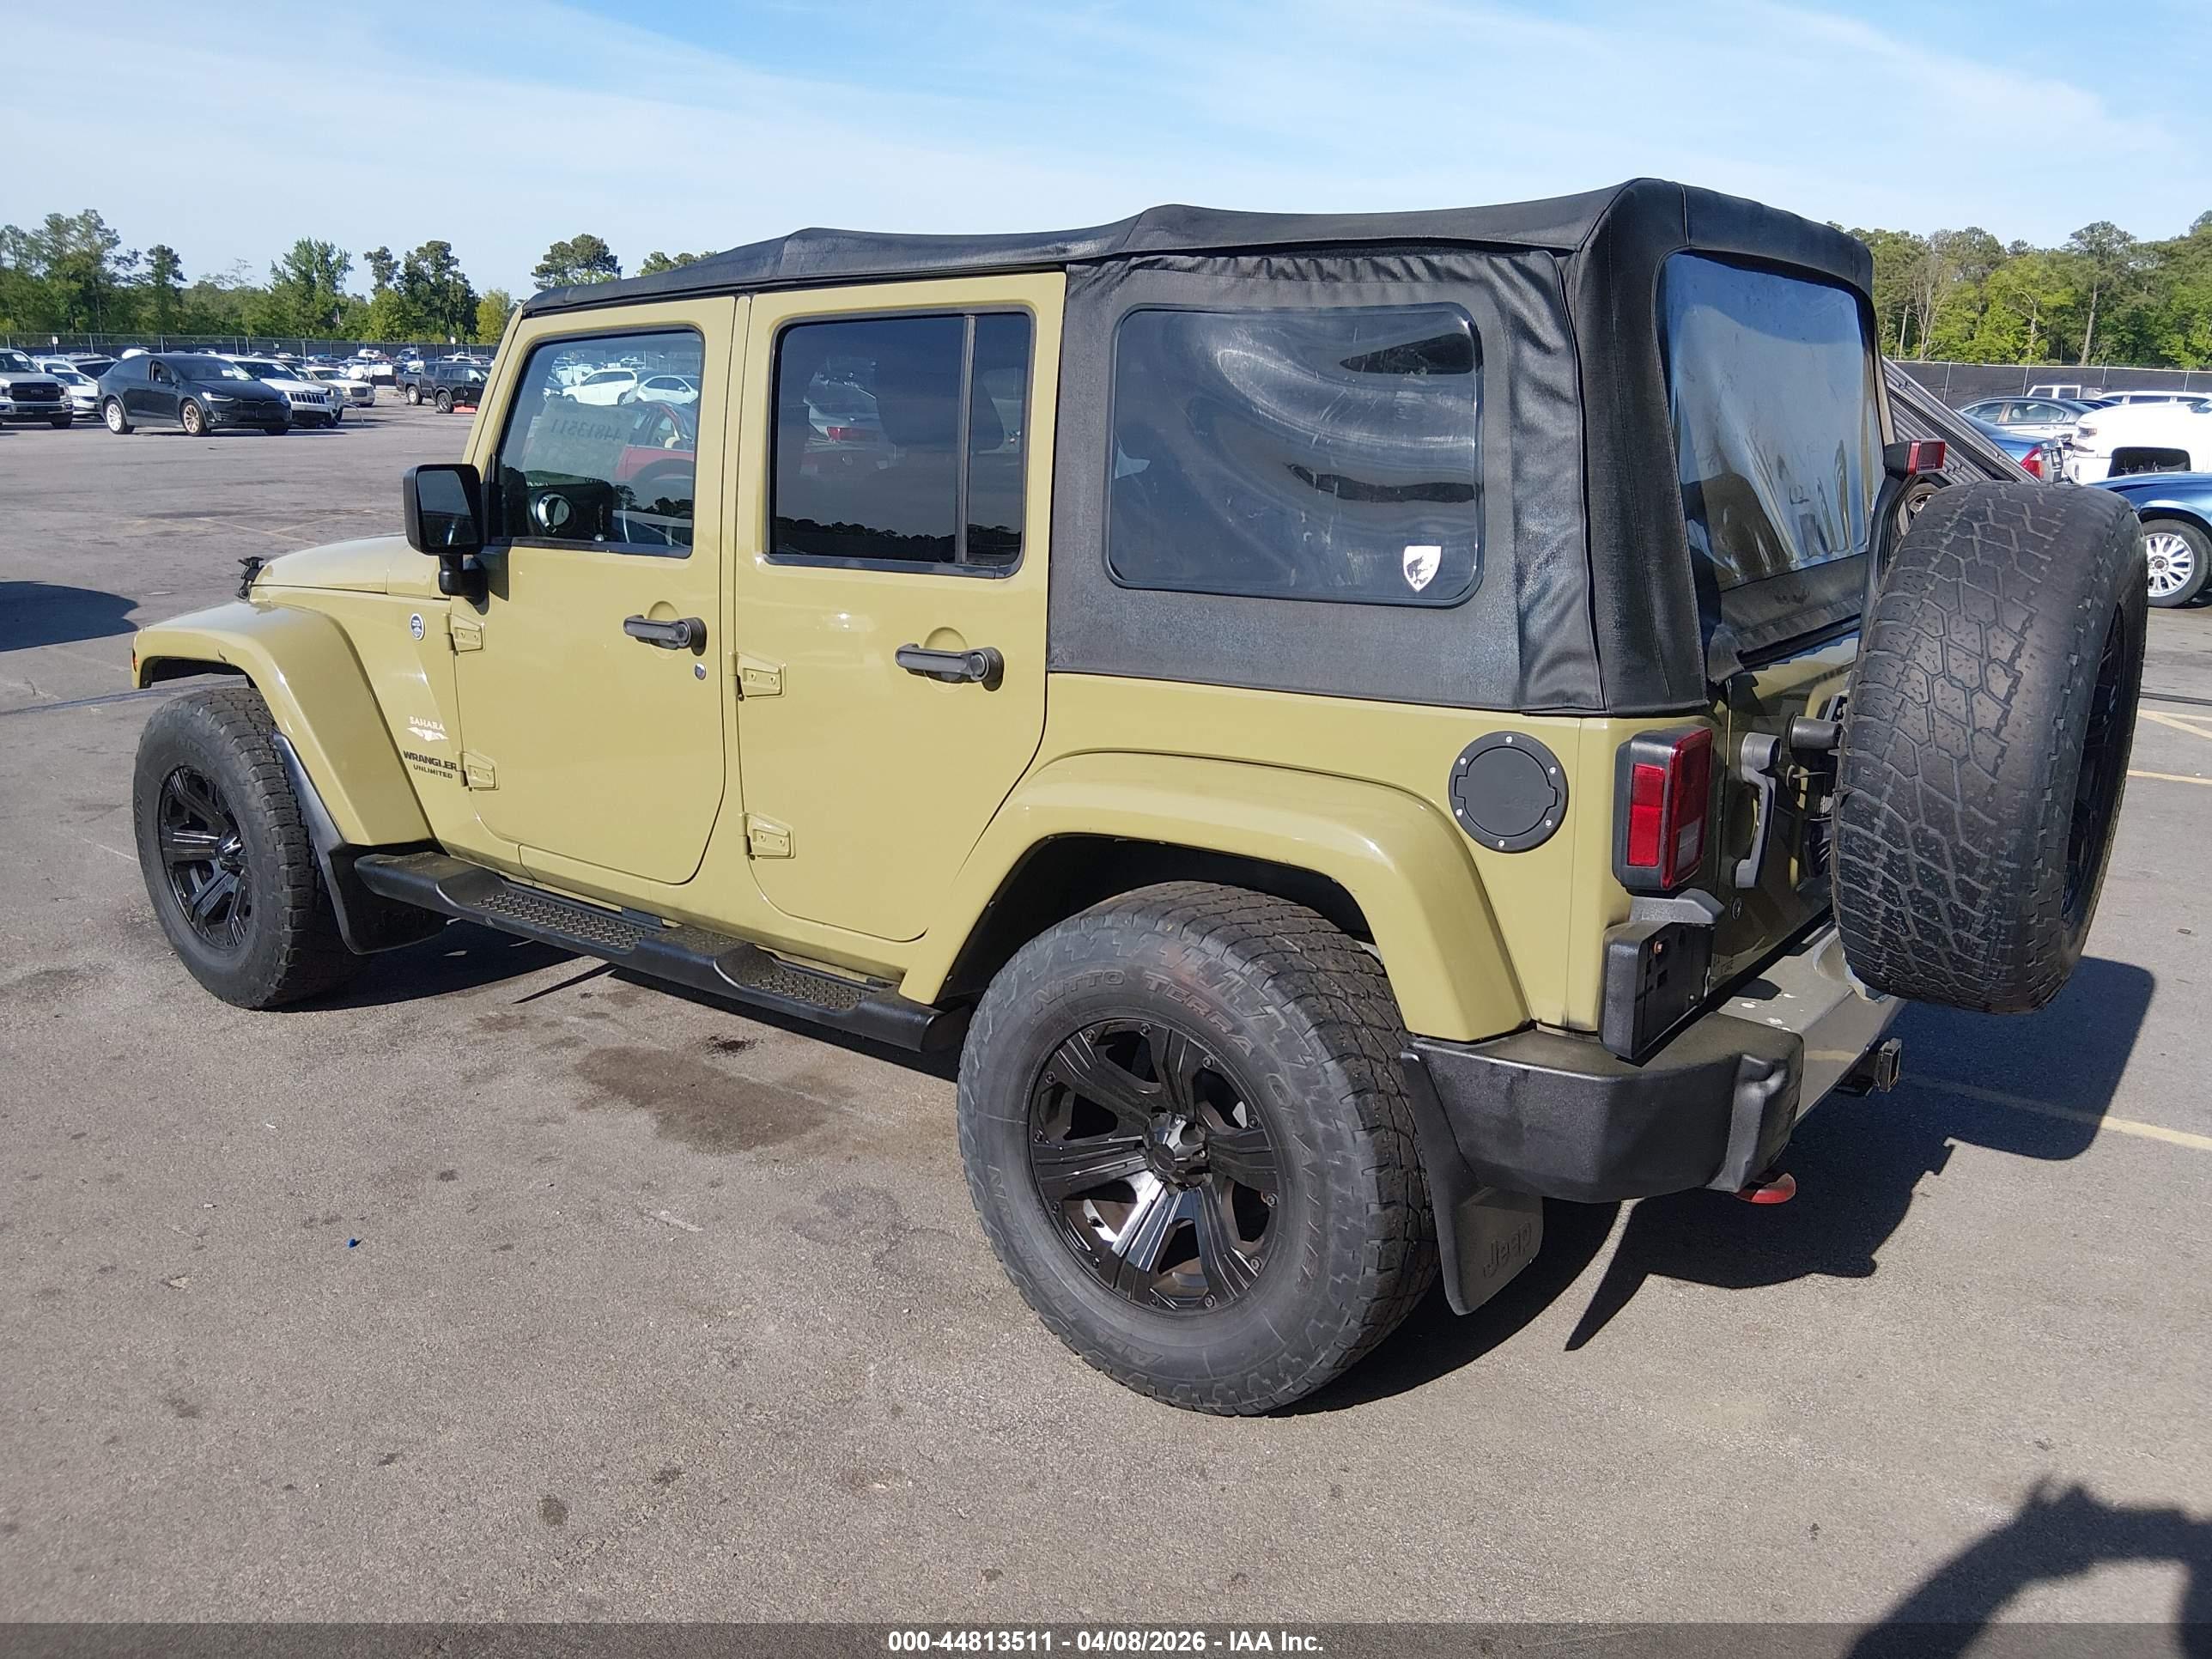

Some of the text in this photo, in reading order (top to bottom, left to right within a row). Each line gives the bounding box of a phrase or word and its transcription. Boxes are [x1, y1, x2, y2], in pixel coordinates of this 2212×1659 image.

[409, 715, 446, 732] SAHARA
[403, 749, 458, 771] WRANGLER
[413, 764, 453, 779] UNLIMITED
[1030, 969, 1255, 1058] NITTO TERRA
[1265, 1071, 1327, 1292] GRAPPLER
[1483, 1221, 1532, 1279] Jeep
